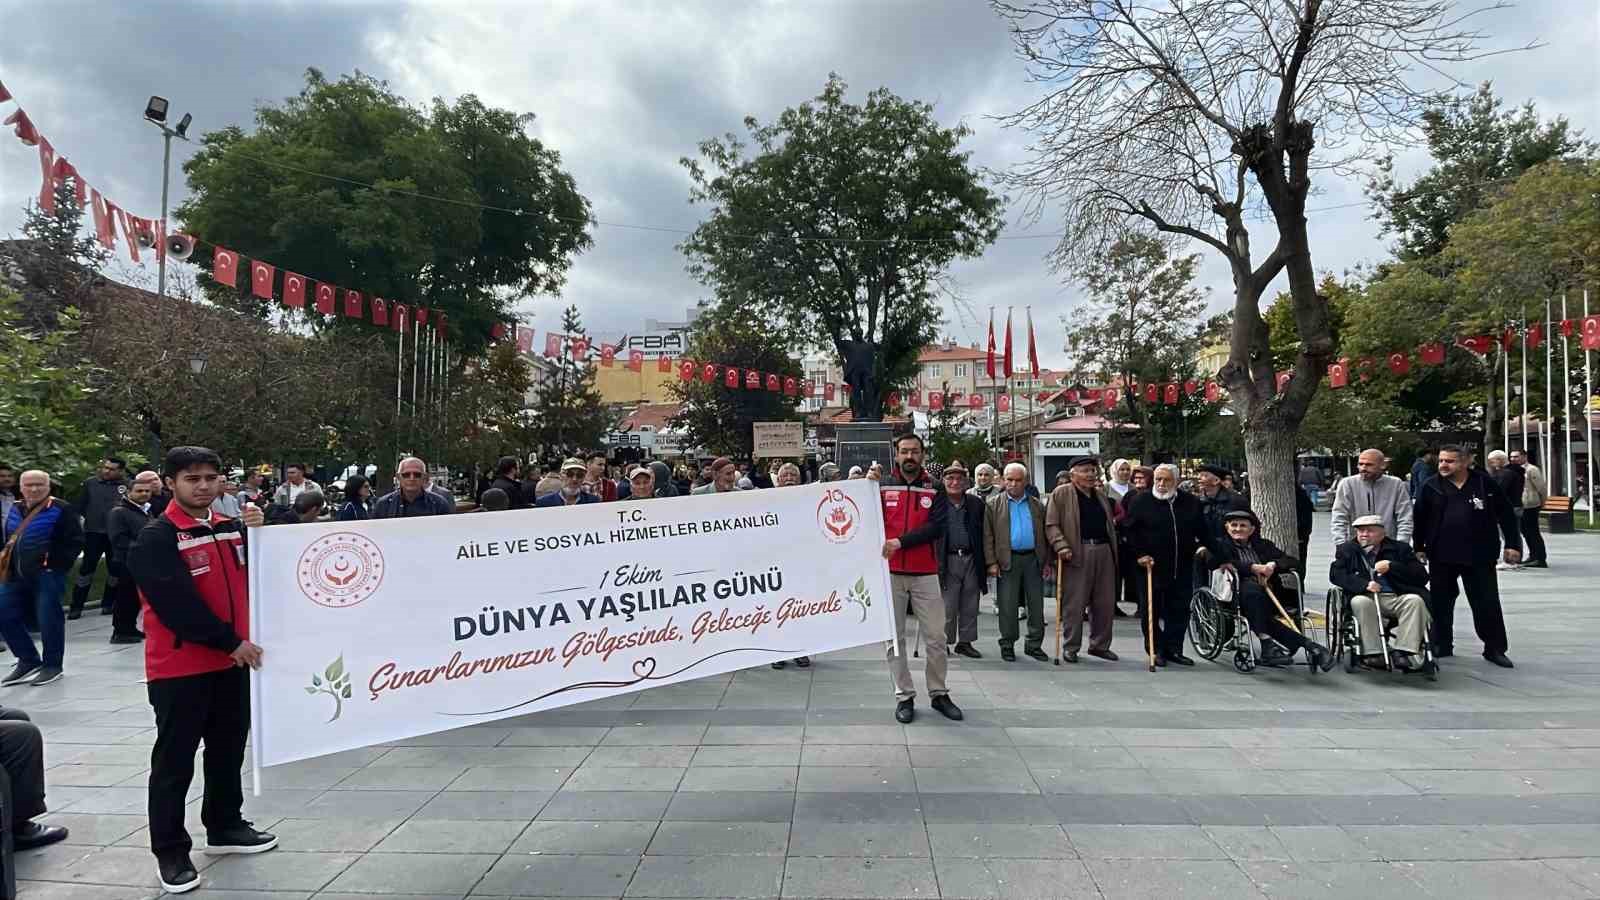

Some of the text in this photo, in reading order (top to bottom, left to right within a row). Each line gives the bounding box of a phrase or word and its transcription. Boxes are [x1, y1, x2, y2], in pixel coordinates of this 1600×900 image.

[629, 335, 681, 349] FBA
[617, 509, 647, 523] T.C.
[456, 511, 779, 560] AİLE VE SOSYAL HİZMETLER BAKANLIĞI
[599, 564, 663, 590] 1 Ekim
[453, 566, 783, 641] DÜNYA YAŞLILAR GÜNÜ
[368, 590, 842, 700] Çınarlarımızın Gölgesinde, Geleceğe Güvenle
